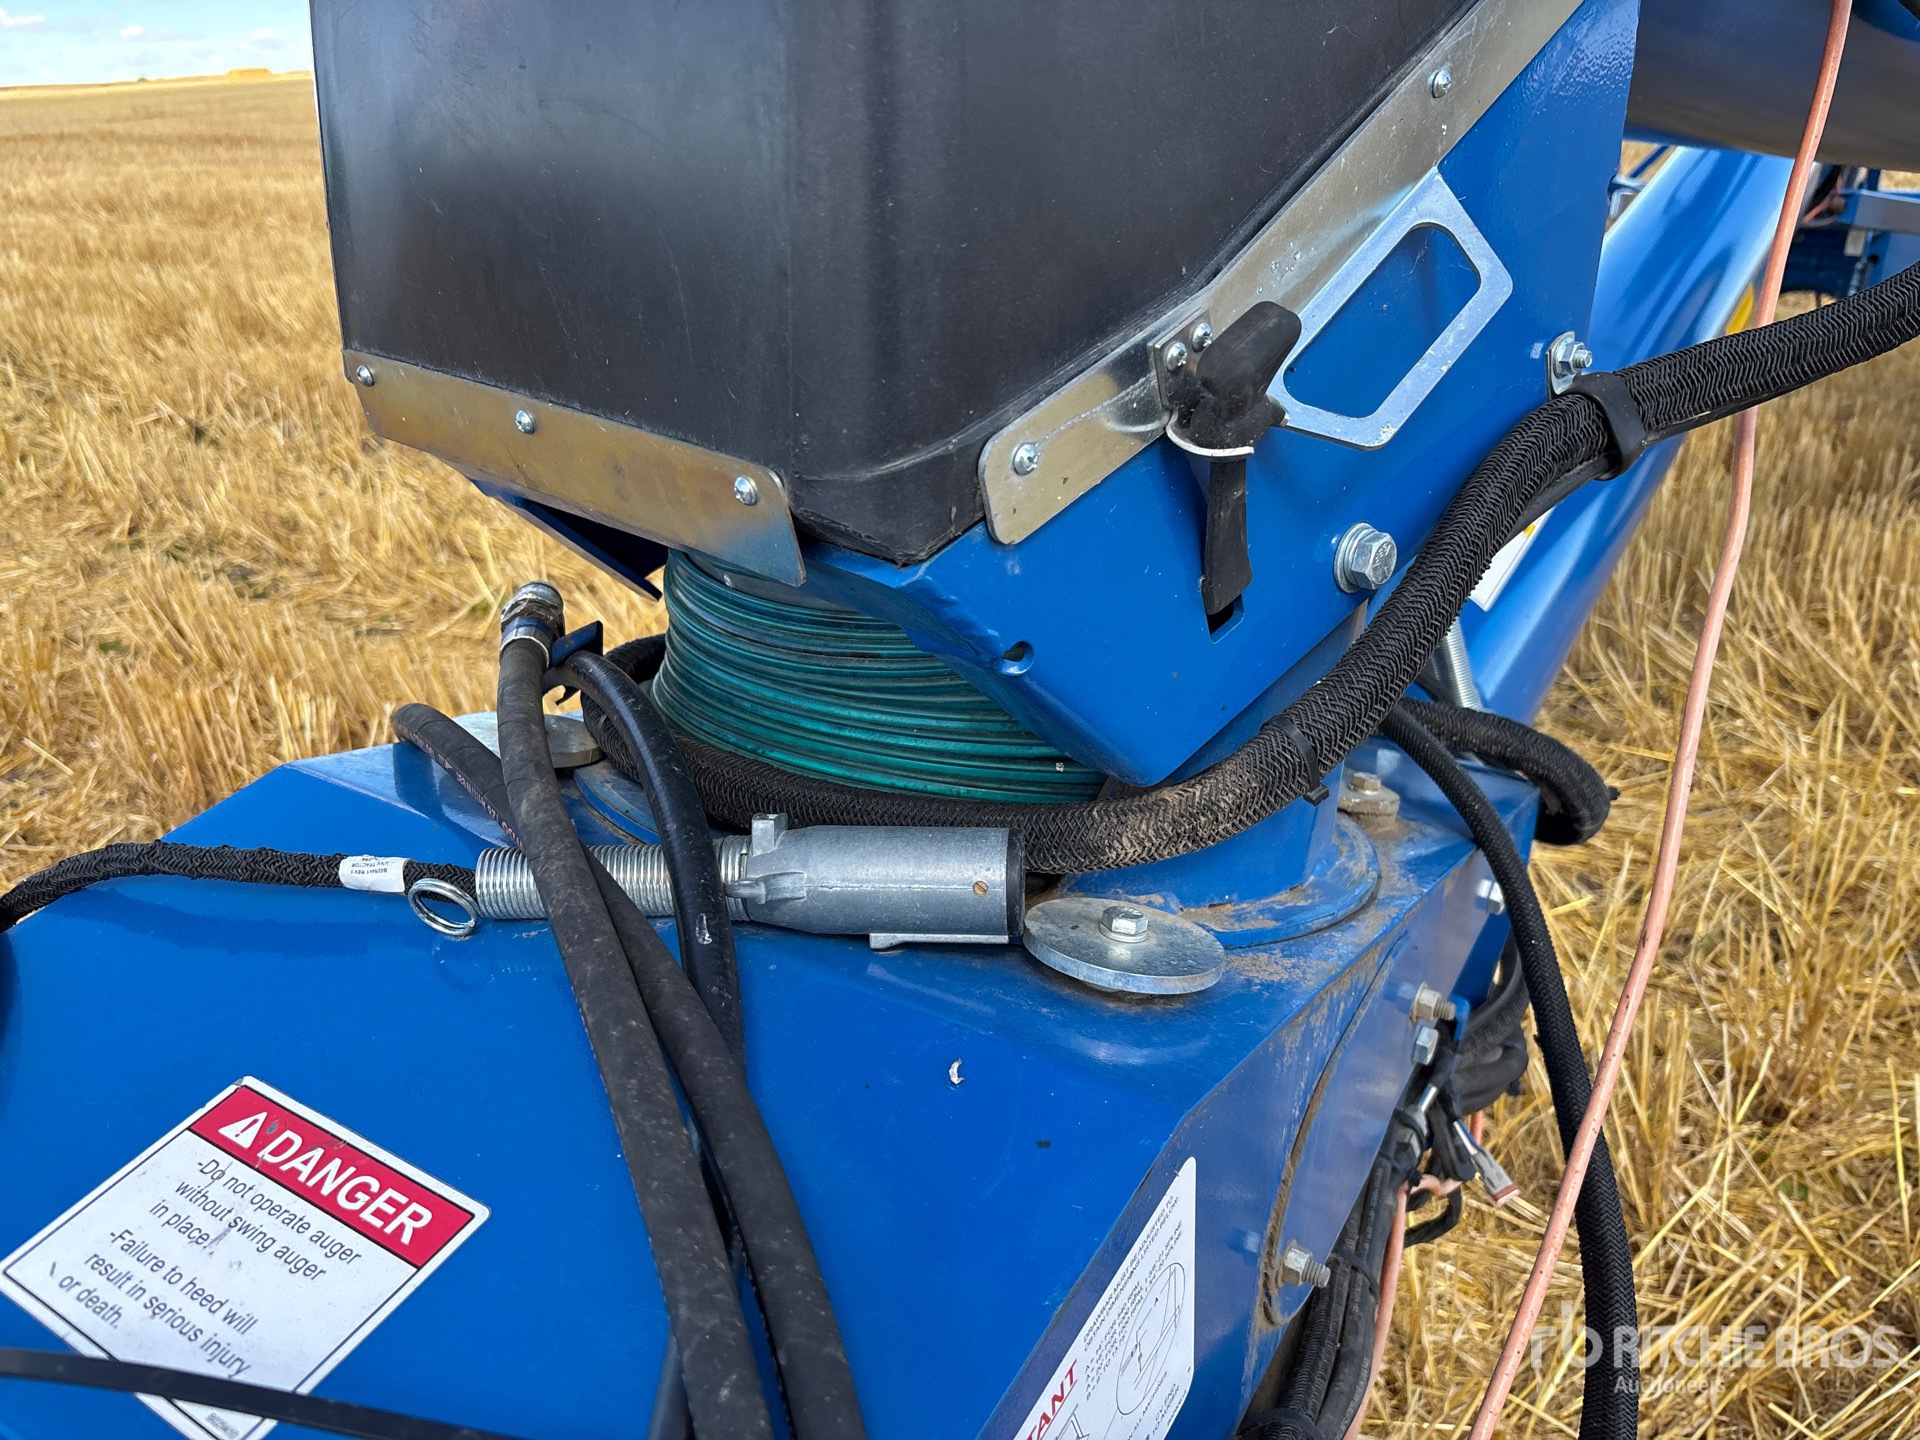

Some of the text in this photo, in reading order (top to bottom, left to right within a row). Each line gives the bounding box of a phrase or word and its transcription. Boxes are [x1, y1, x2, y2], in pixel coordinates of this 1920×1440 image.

[149, 1199, 169, 1219] in
[175, 1181, 327, 1281] without swing auger
[197, 1158, 362, 1265] -Do not operate auger
[257, 1129, 433, 1246] DANGER
[58, 1275, 123, 1330] or death.
[84, 1253, 252, 1380] result in serious injury
[110, 1229, 259, 1335] -Failure to heed will
[1084, 1293, 1113, 1342] DRAWBAR
[1113, 1263, 1129, 1294] MUST
[1138, 1208, 1166, 1256] ADJUSTED
[1084, 1316, 1106, 1352] OBTAIN
[1106, 1258, 1140, 1317] DIMENSIONS
[1140, 1228, 1160, 1260] LISTED
[1104, 1319, 1116, 1340] FOR
[1128, 1280, 1140, 1304] RPM
[1104, 1328, 1116, 1350] FOR
[1118, 1307, 1130, 1328] 1000
[1105, 1338, 1117, 1360] FOR
[1118, 1316, 1130, 1338] 1000
